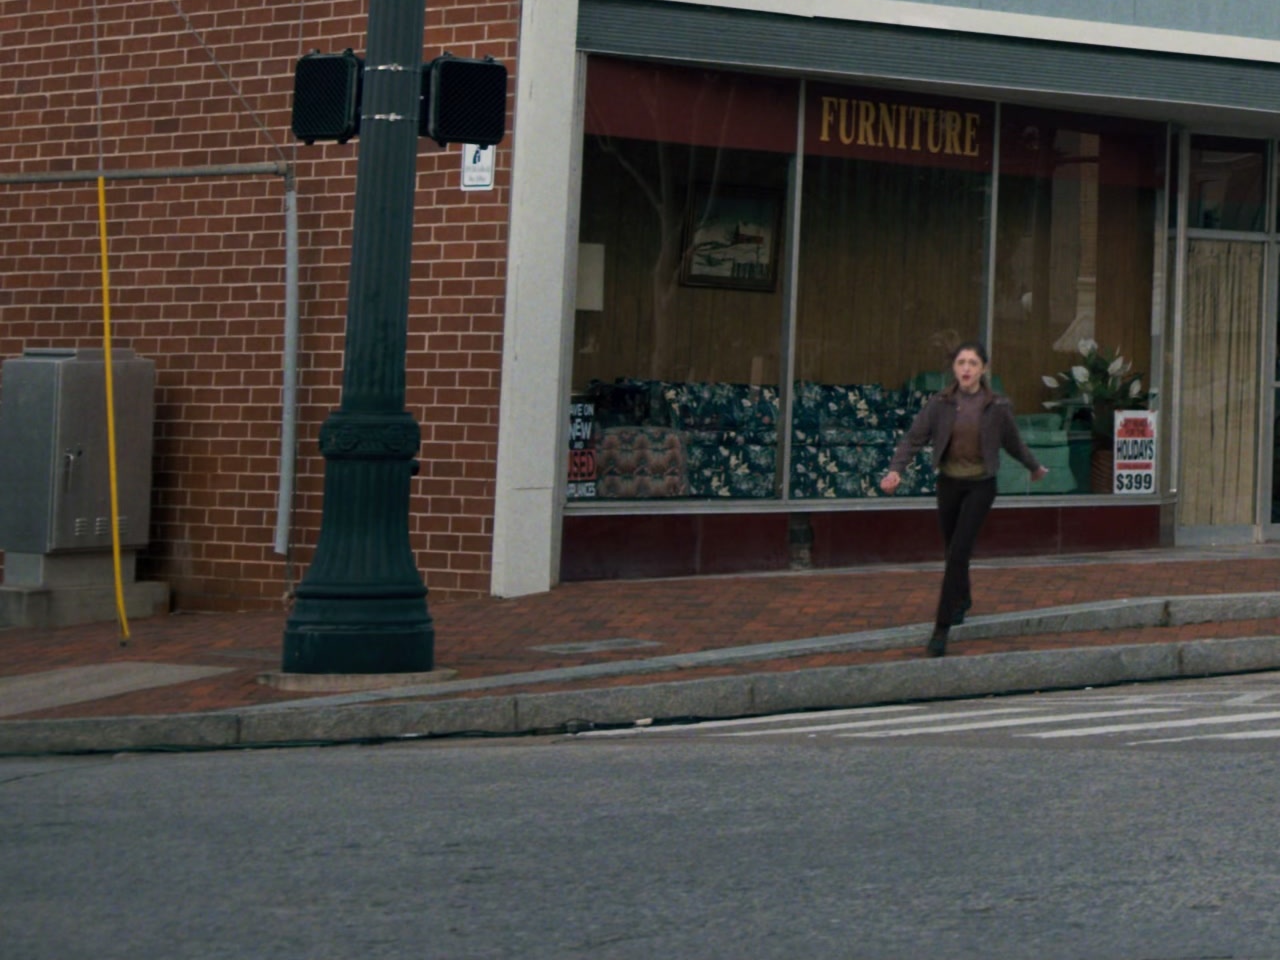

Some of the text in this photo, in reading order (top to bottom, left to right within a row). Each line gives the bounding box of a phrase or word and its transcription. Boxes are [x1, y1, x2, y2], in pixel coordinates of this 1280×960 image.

[820, 95, 980, 157] FURNITURE
[1116, 439, 1154, 461] HOLIDAYS
[1116, 473, 1152, 491] $399
